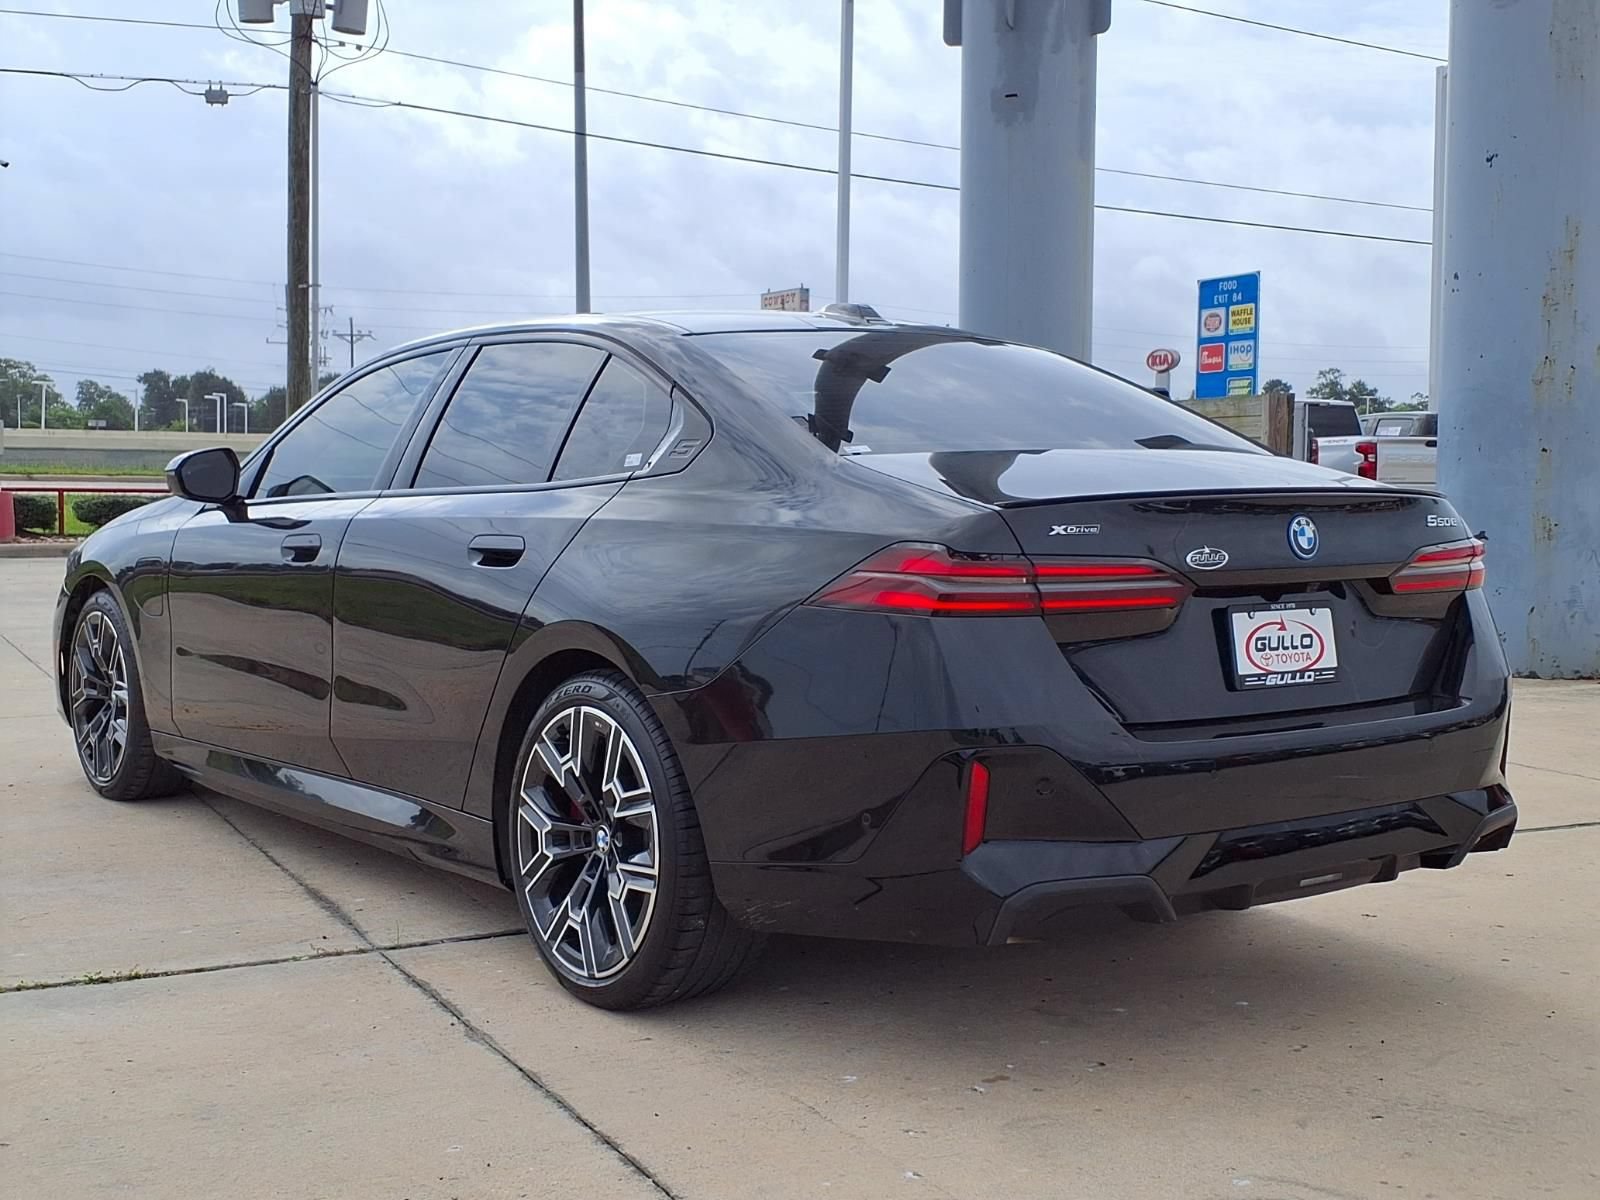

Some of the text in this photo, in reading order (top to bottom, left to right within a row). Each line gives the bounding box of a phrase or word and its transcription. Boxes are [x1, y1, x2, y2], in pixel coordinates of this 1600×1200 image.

[1219, 280, 1237, 291] FOOD
[1214, 294, 1228, 304] EXIT
[1231, 307, 1253, 317] WAFFLE
[1231, 316, 1251, 326] HOUSE
[1150, 354, 1170, 367] KIA
[1190, 553, 1226, 564] GULLO
[1255, 634, 1313, 652] GULLO
[1275, 652, 1312, 664] TOYOTA
[1266, 671, 1315, 685] GULLO
[555, 685, 593, 700] ZERO
